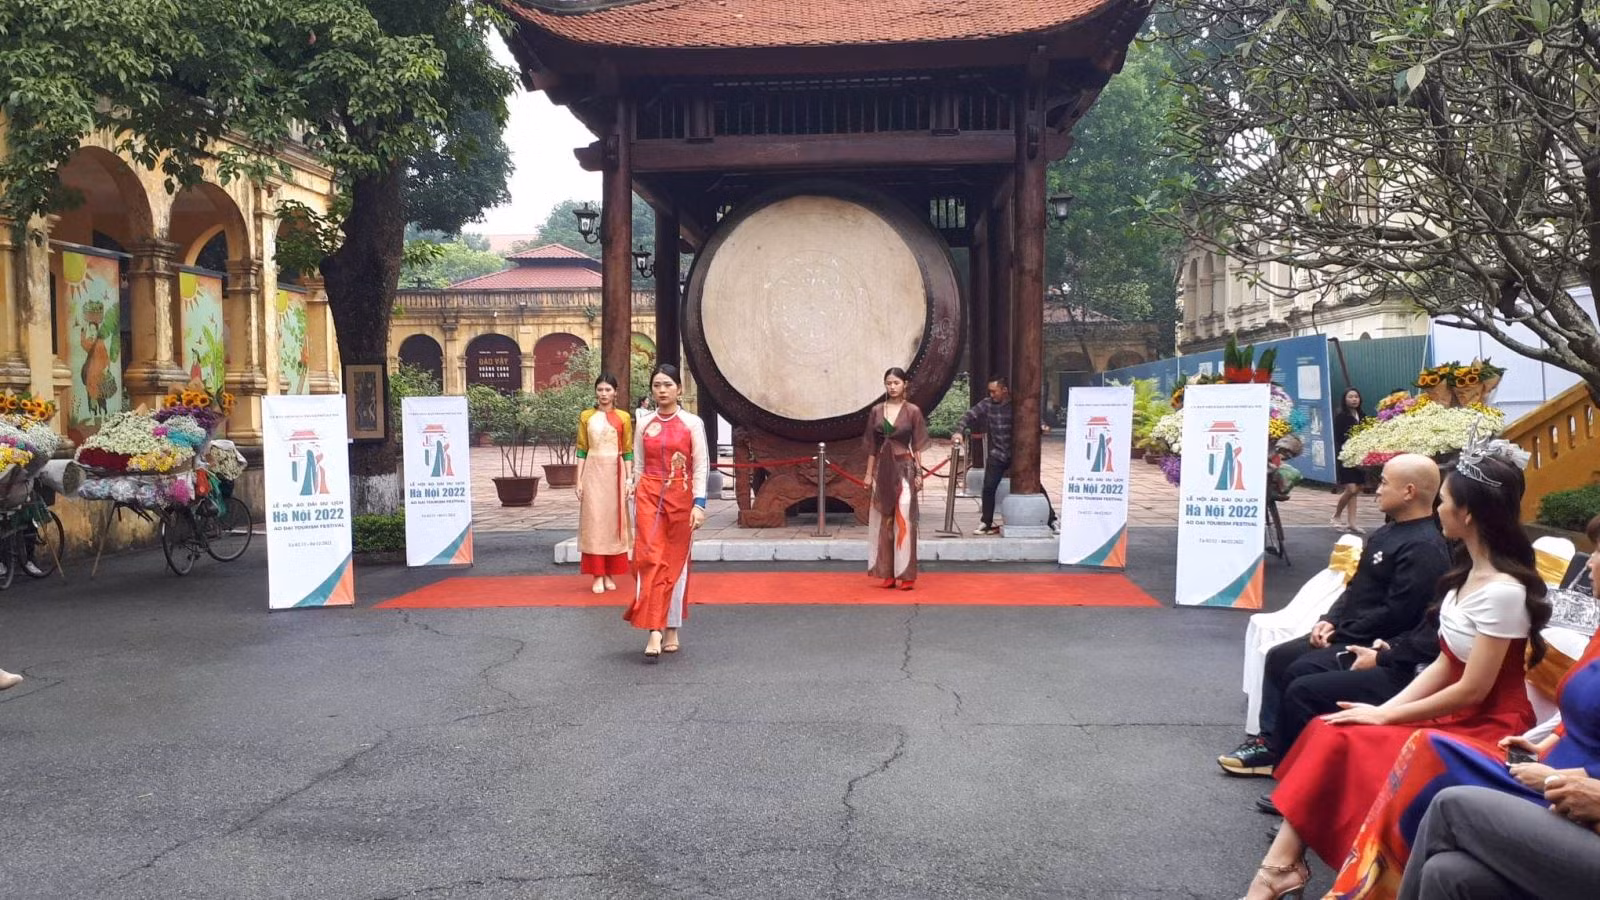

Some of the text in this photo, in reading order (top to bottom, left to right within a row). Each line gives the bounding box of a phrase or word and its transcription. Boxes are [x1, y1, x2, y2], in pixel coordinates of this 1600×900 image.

[410, 487, 466, 500] Hà Nội 2022
[1068, 483, 1123, 496] Hà Nội 2022
[272, 508, 344, 524] Hà Nội 2022
[1186, 504, 1258, 520] Hà Nội 2022
